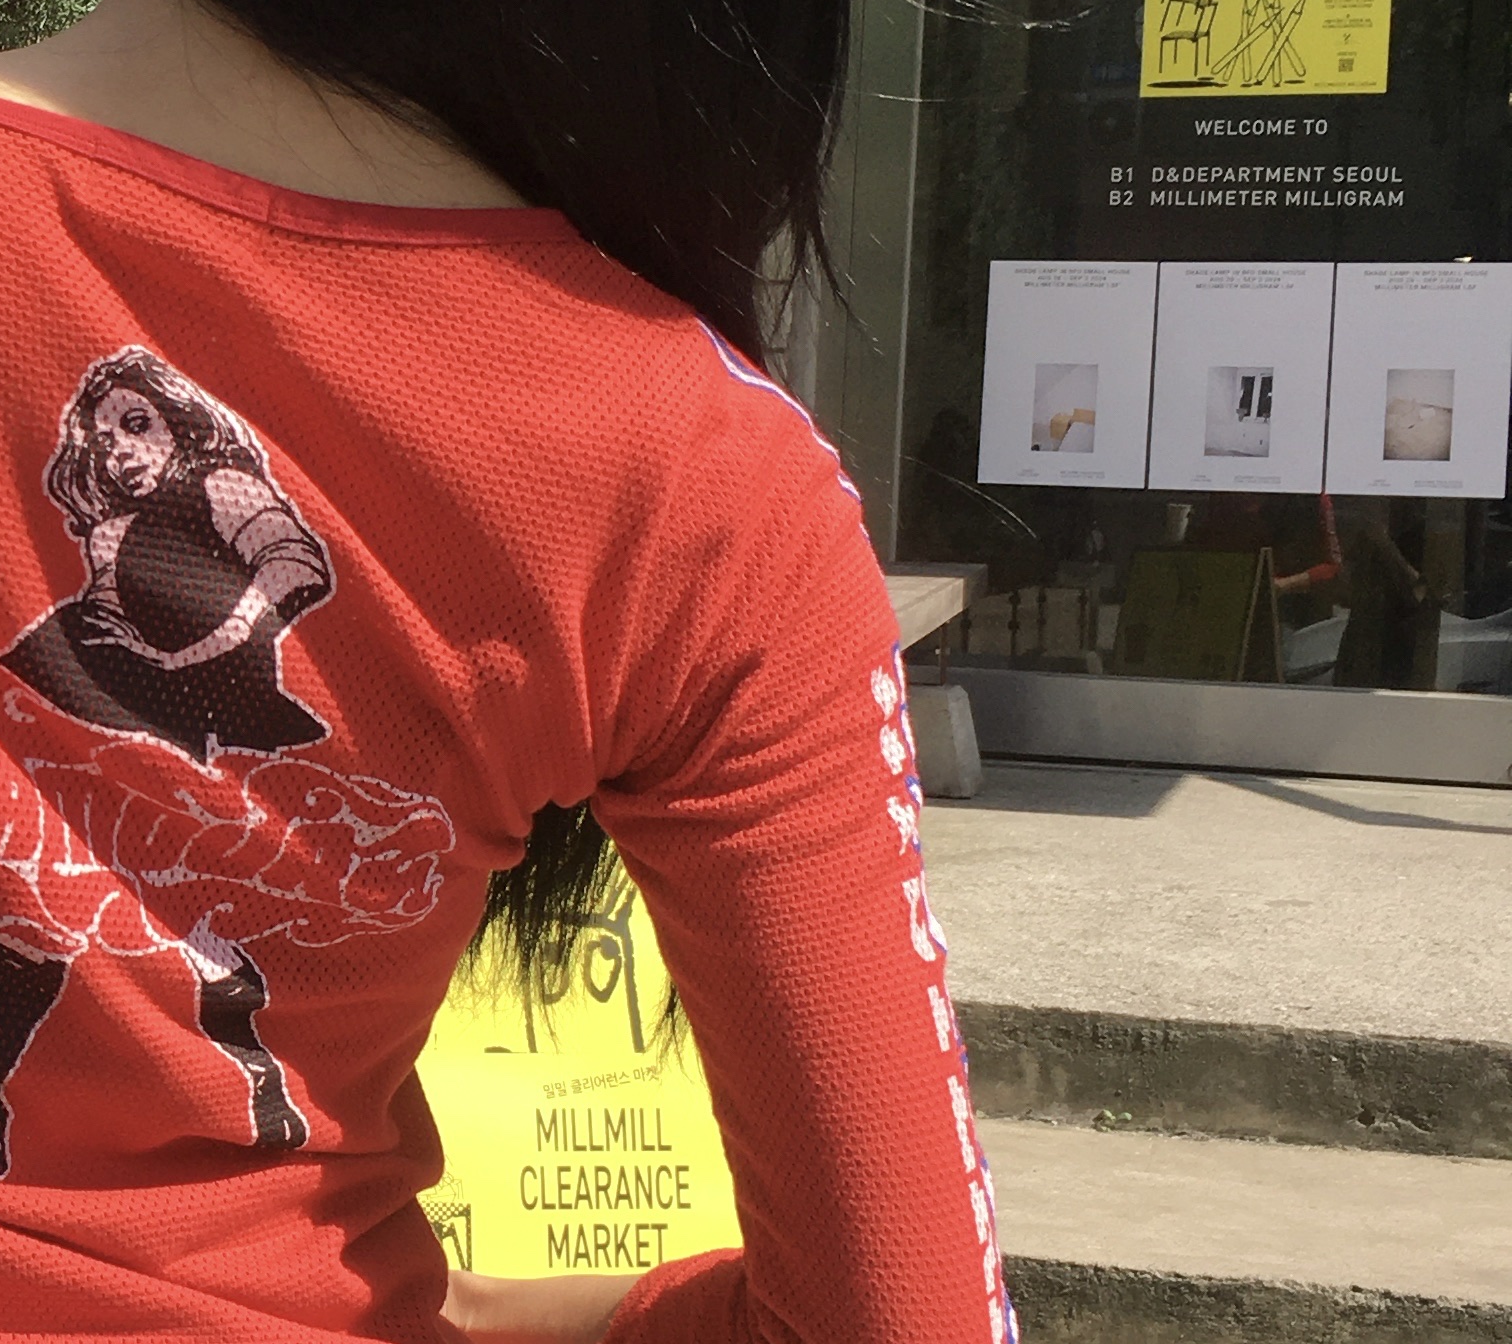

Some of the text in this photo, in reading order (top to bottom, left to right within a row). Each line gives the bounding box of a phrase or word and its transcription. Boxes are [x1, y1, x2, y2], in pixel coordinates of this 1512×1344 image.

[1194, 119, 1328, 136] WELCOME TO
[1110, 166, 1403, 183] B1 D&DEPARTMENT SEOUL
[1109, 190, 1404, 207] B2 MILLIMETER MILLIGRAM
[542, 1081, 567, 1099] 밀밀
[570, 1071, 631, 1095] 클리어런스
[535, 1107, 673, 1153] MILLMILL
[519, 1164, 692, 1211] CLEARANCE
[547, 1223, 668, 1269] MARKET
